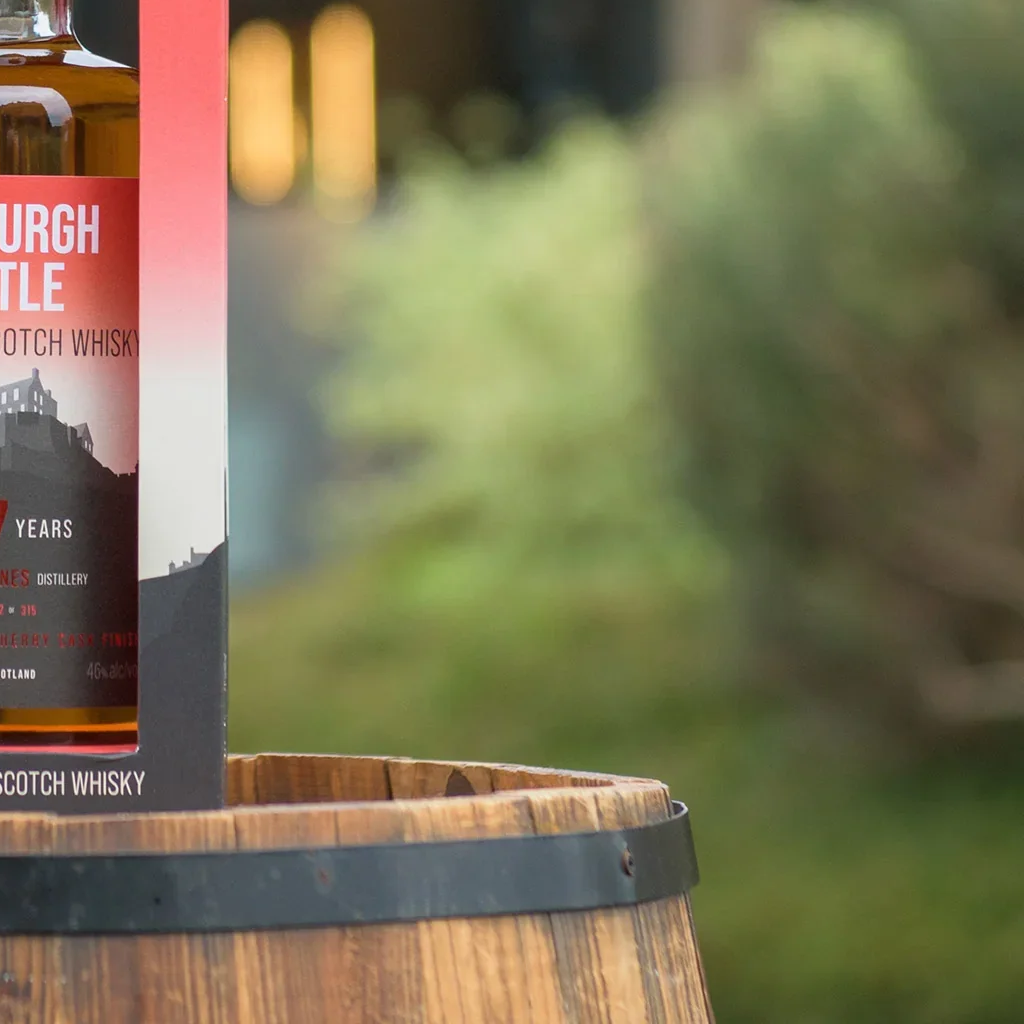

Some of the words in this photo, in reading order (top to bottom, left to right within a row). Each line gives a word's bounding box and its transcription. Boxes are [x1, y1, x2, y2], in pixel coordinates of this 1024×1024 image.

[15, 519, 73, 539] YEARS
[37, 573, 88, 586] DISTILLERY
[20, 604, 37, 616] 315
[58, 632, 96, 648] CASK
[71, 770, 145, 796] WHISKY
